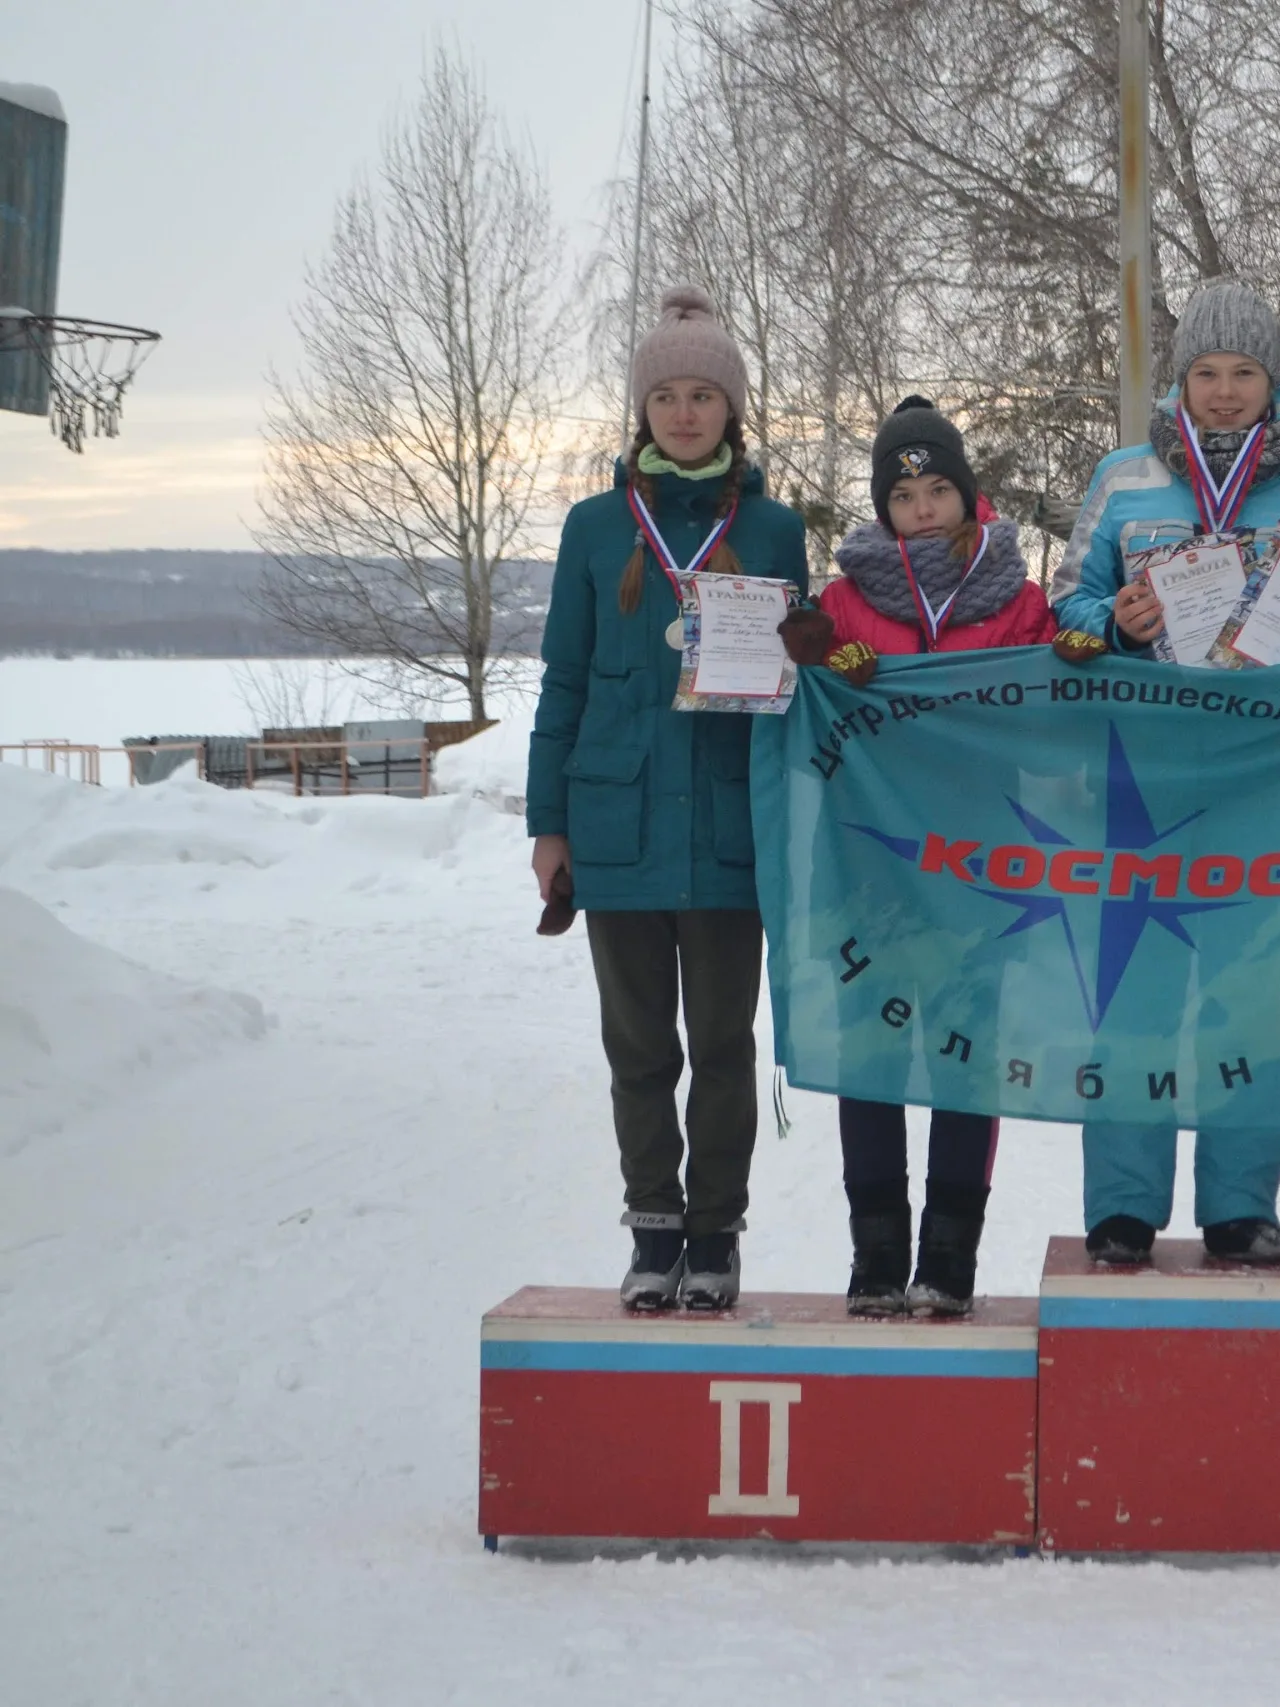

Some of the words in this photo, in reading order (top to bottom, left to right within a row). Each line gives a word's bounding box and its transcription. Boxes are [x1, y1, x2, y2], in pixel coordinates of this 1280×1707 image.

[1161, 557, 1231, 586] ГРАМОТА
[707, 589, 776, 603] ГРАМОТА
[809, 703, 884, 781] Центр
